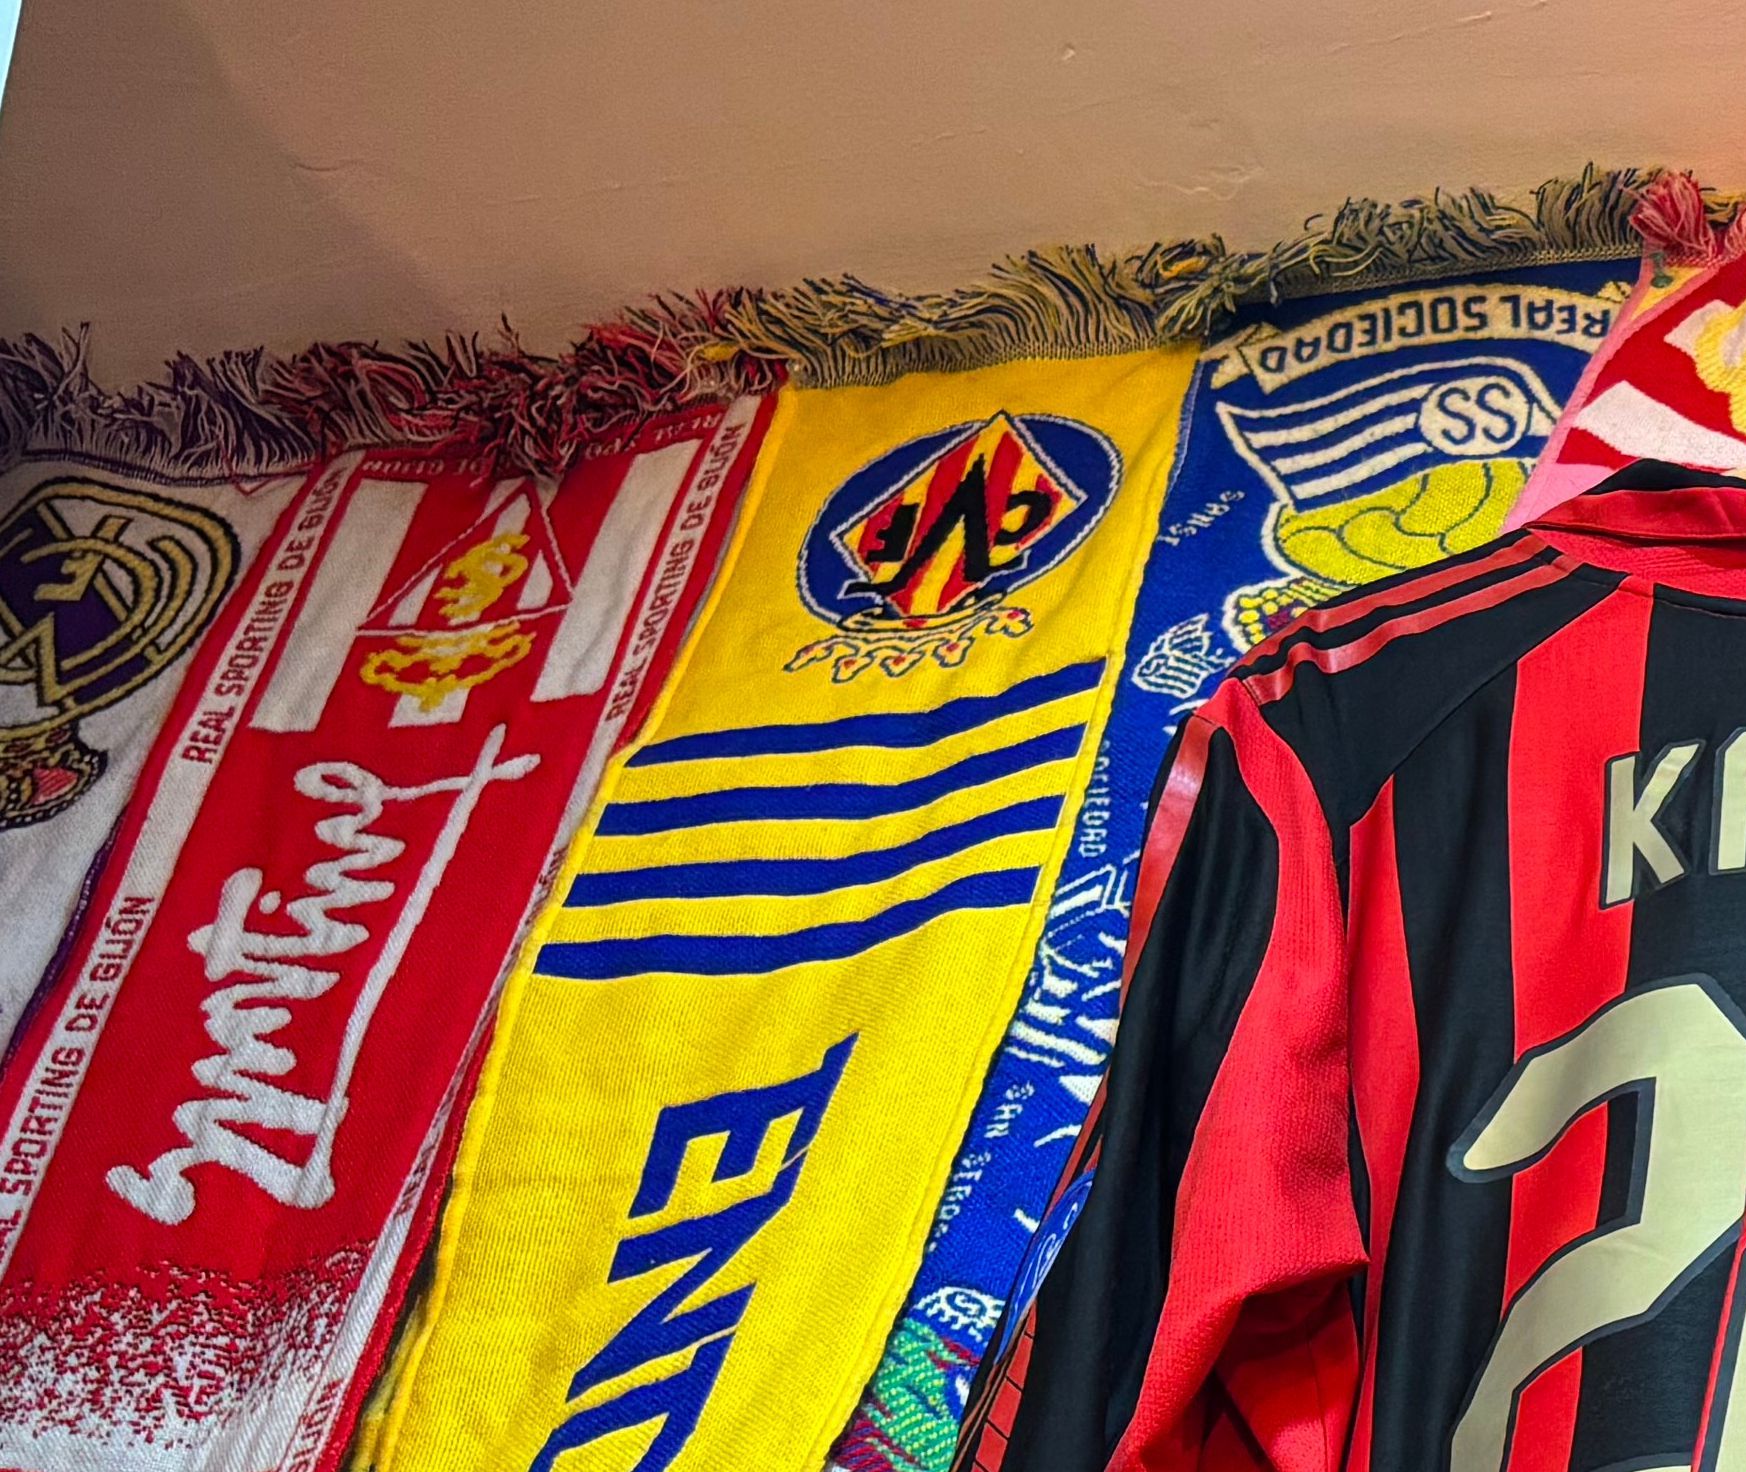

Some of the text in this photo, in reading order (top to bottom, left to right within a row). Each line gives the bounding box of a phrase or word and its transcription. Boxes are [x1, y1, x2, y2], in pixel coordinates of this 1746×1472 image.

[1259, 292, 1612, 376] REAL SOCIEDAD
[633, 537, 696, 655] SPORTING
[679, 494, 712, 536] DE
[181, 705, 236, 765] REAL
[214, 579, 296, 698] SPORTING
[277, 535, 316, 572] DE
[65, 991, 111, 1034] DE
